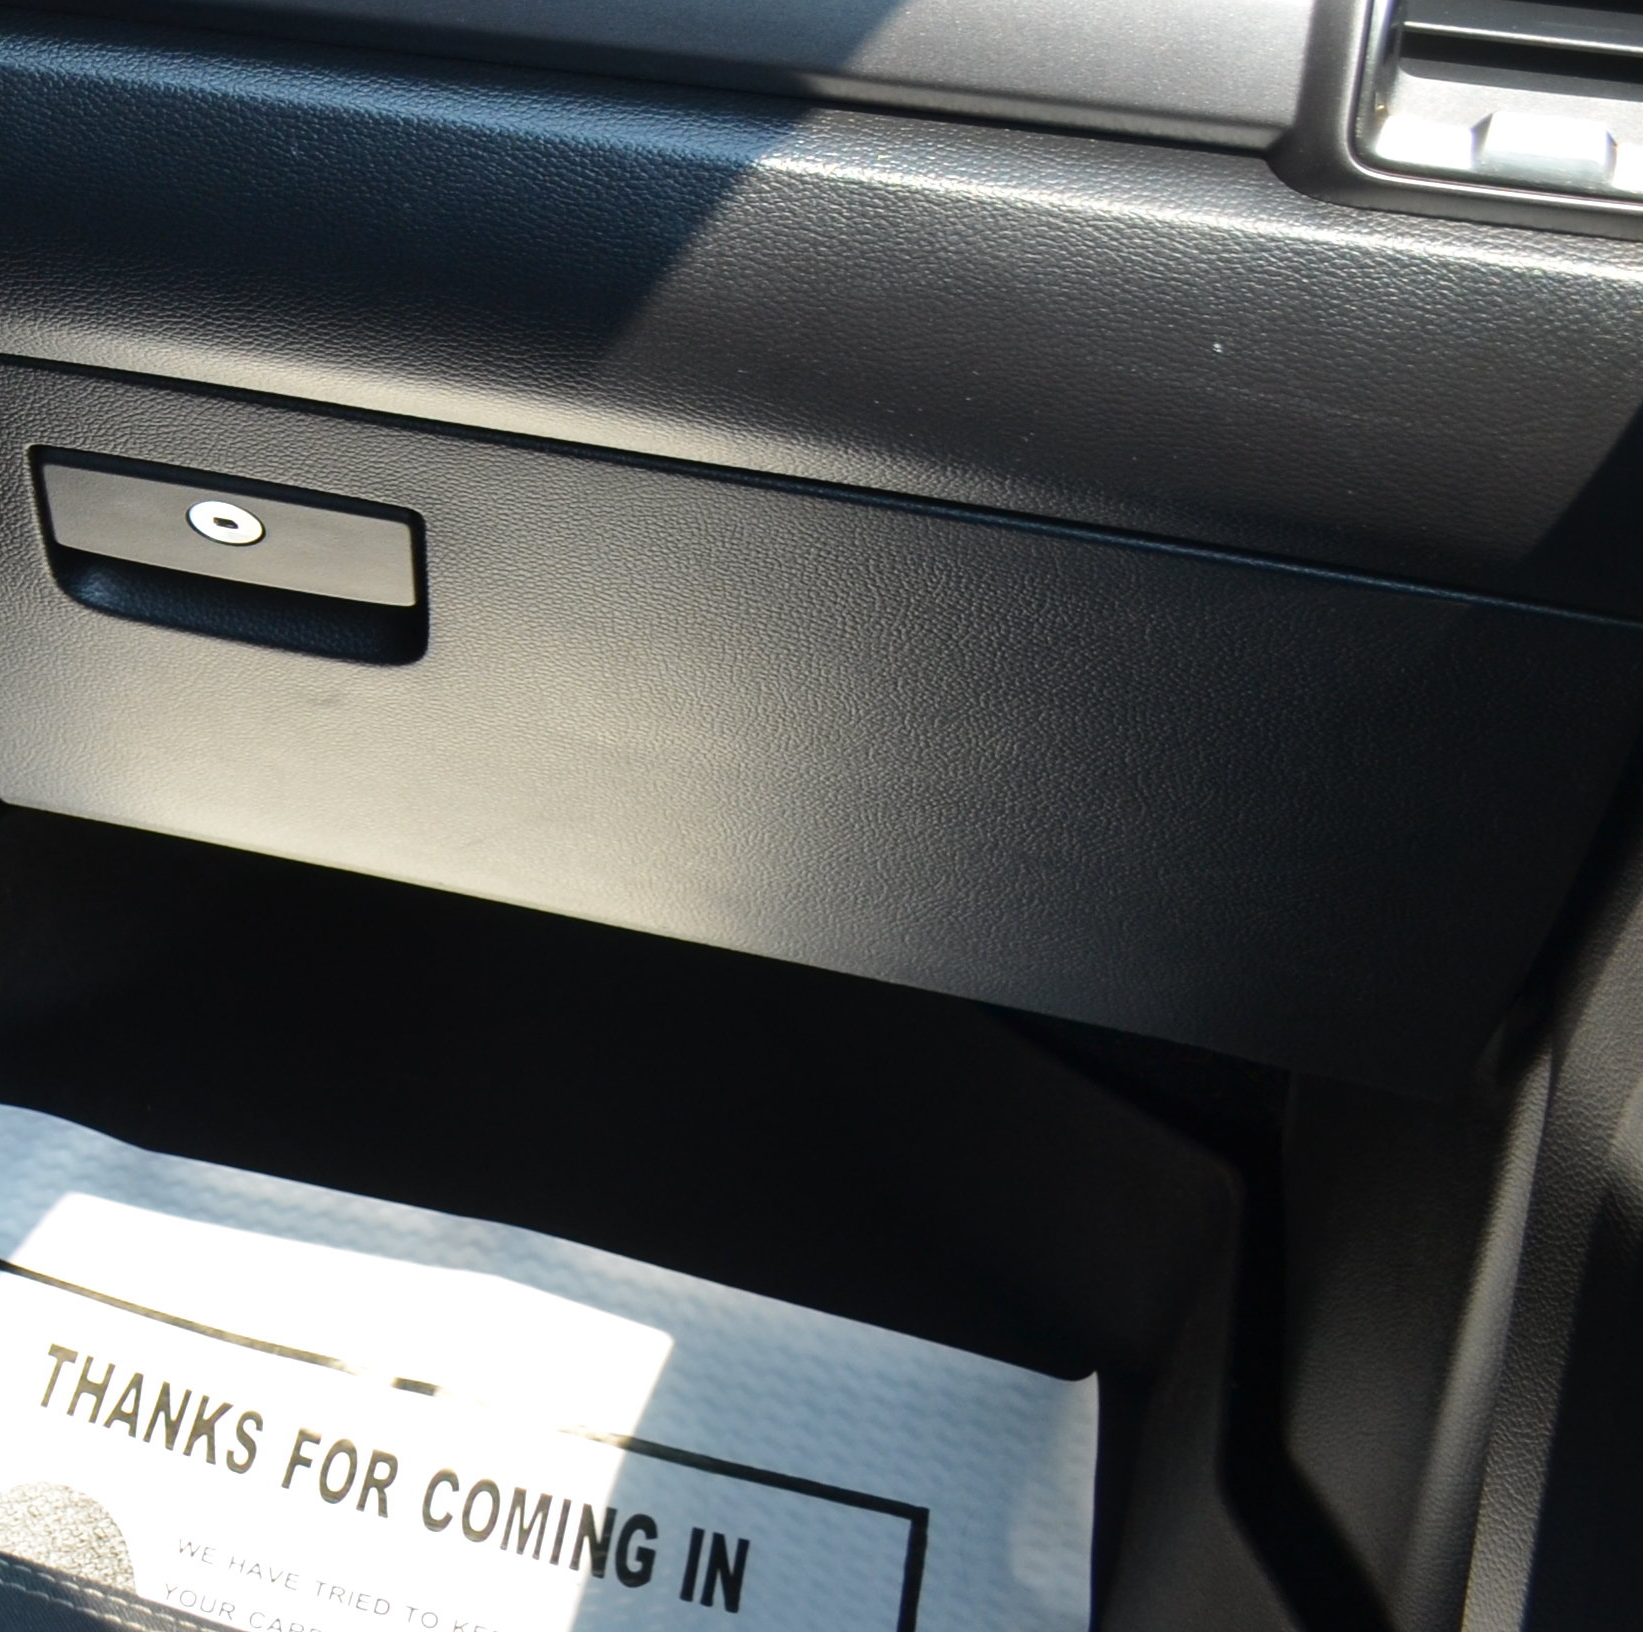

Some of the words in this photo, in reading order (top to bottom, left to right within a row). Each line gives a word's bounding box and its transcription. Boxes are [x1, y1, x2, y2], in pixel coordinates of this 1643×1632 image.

[40, 1344, 264, 1474] THANKS
[281, 1428, 399, 1518] FOR
[423, 1470, 659, 1589] COMING
[680, 1527, 751, 1614] IN
[164, 1582, 236, 1621] YOUR
[178, 1538, 216, 1565] WE
[229, 1556, 300, 1591] HAVE
[315, 1579, 391, 1616] TRIED
[405, 1606, 439, 1629] TO
